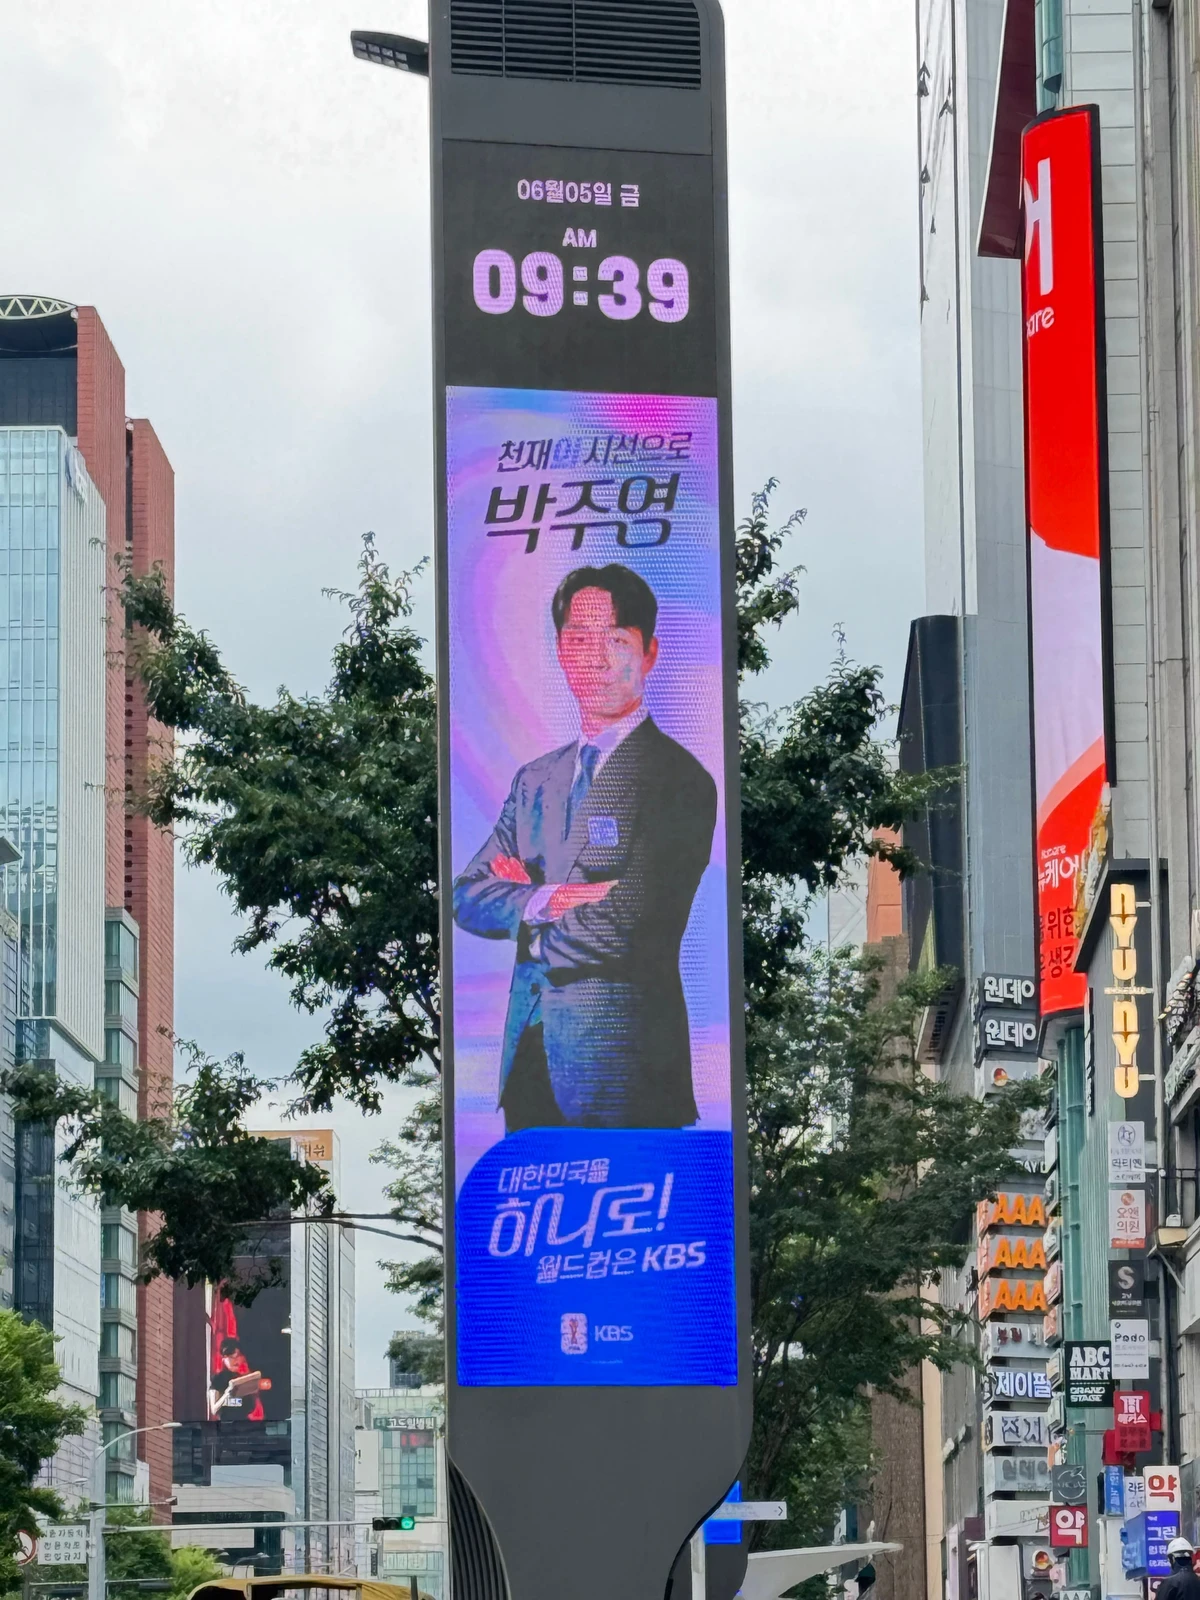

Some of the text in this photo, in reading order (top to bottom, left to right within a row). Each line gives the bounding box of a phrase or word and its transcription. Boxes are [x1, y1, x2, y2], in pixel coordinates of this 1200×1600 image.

[517, 179, 640, 207] 06월05일 금
[562, 227, 597, 248] AM
[473, 248, 689, 323] 09:39
[583, 431, 693, 466] 시선으로
[484, 473, 681, 554] 박주영
[498, 1157, 610, 1193] 대한민국을
[488, 1172, 674, 1257] 하나로!
[536, 1241, 706, 1284] 월드컵은 KBS
[994, 1237, 1047, 1269] AAA
[1118, 1266, 1135, 1290] S
[994, 1279, 1048, 1312] AAA
[594, 1325, 634, 1341] KBS
[1070, 1346, 1110, 1366] ABC
[1070, 1367, 1110, 1380] MART
[1148, 1475, 1177, 1503] 약
[1055, 1509, 1085, 1545] 약
